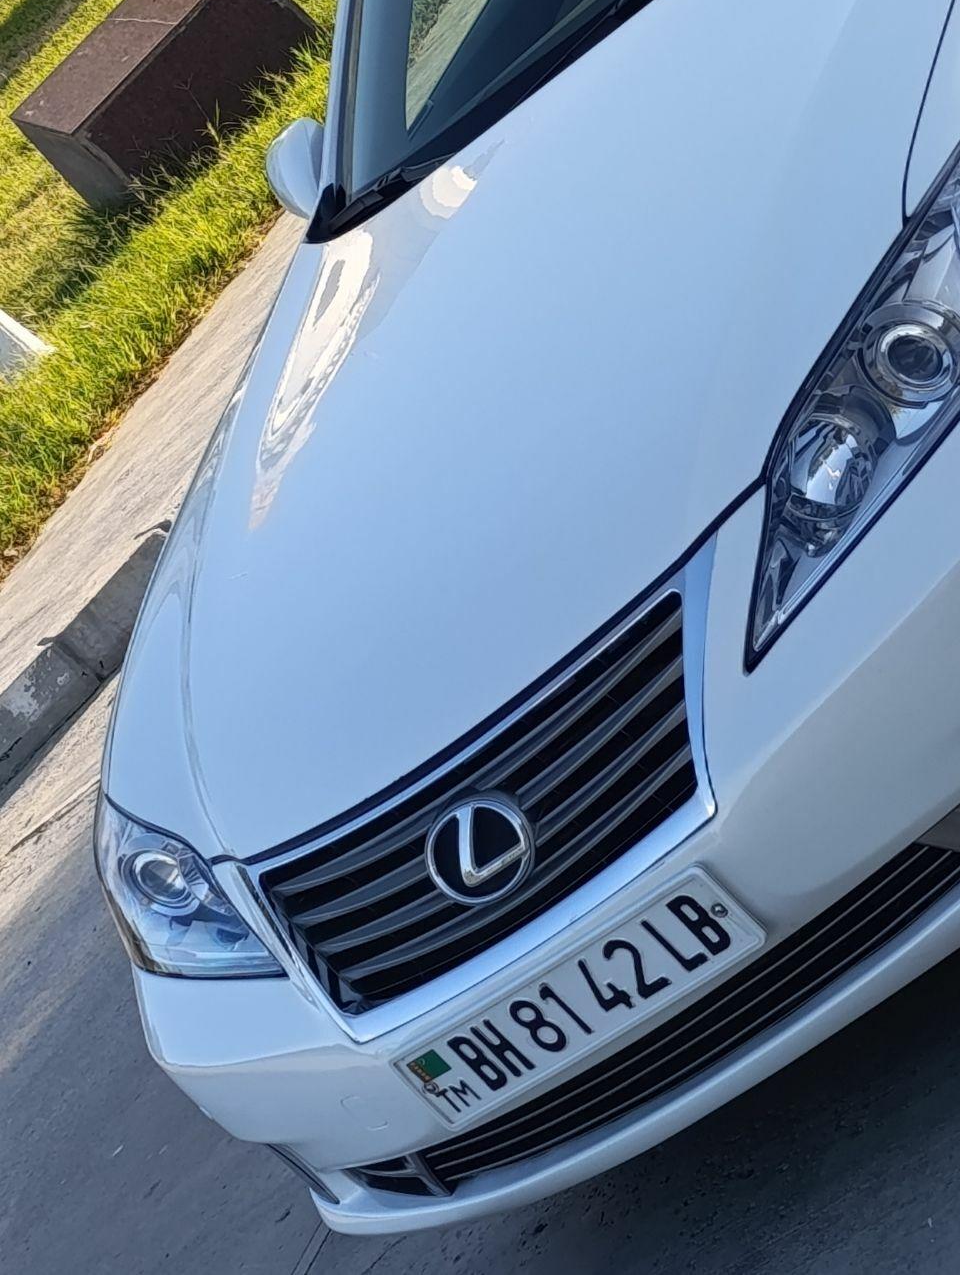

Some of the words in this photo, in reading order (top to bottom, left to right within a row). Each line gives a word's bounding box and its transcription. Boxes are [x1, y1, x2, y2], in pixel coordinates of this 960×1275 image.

[446, 1018, 536, 1092] BH
[640, 894, 732, 973] LB
[436, 1079, 482, 1113] TM
